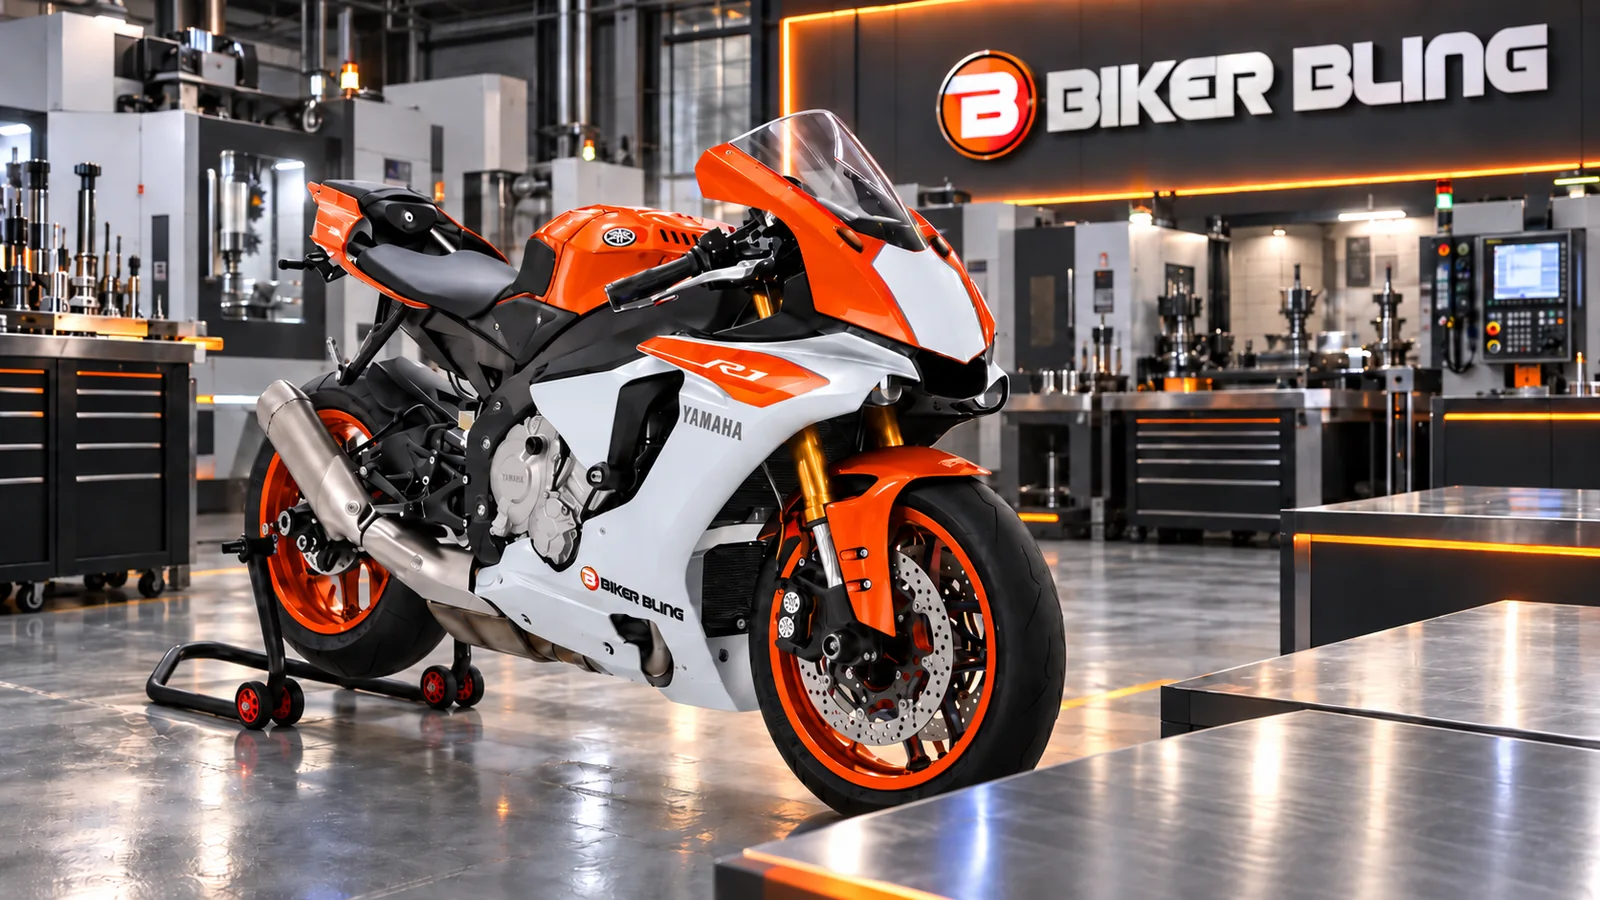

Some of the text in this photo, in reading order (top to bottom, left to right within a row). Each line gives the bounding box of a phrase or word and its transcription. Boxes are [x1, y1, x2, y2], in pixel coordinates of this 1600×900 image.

[1046, 51, 1274, 133] BIKER
[1292, 23, 1548, 112] BLING
[703, 359, 768, 381] R1
[683, 404, 743, 441] YAMAHA
[600, 577, 640, 604] BIKER
[642, 595, 684, 622] BLING
